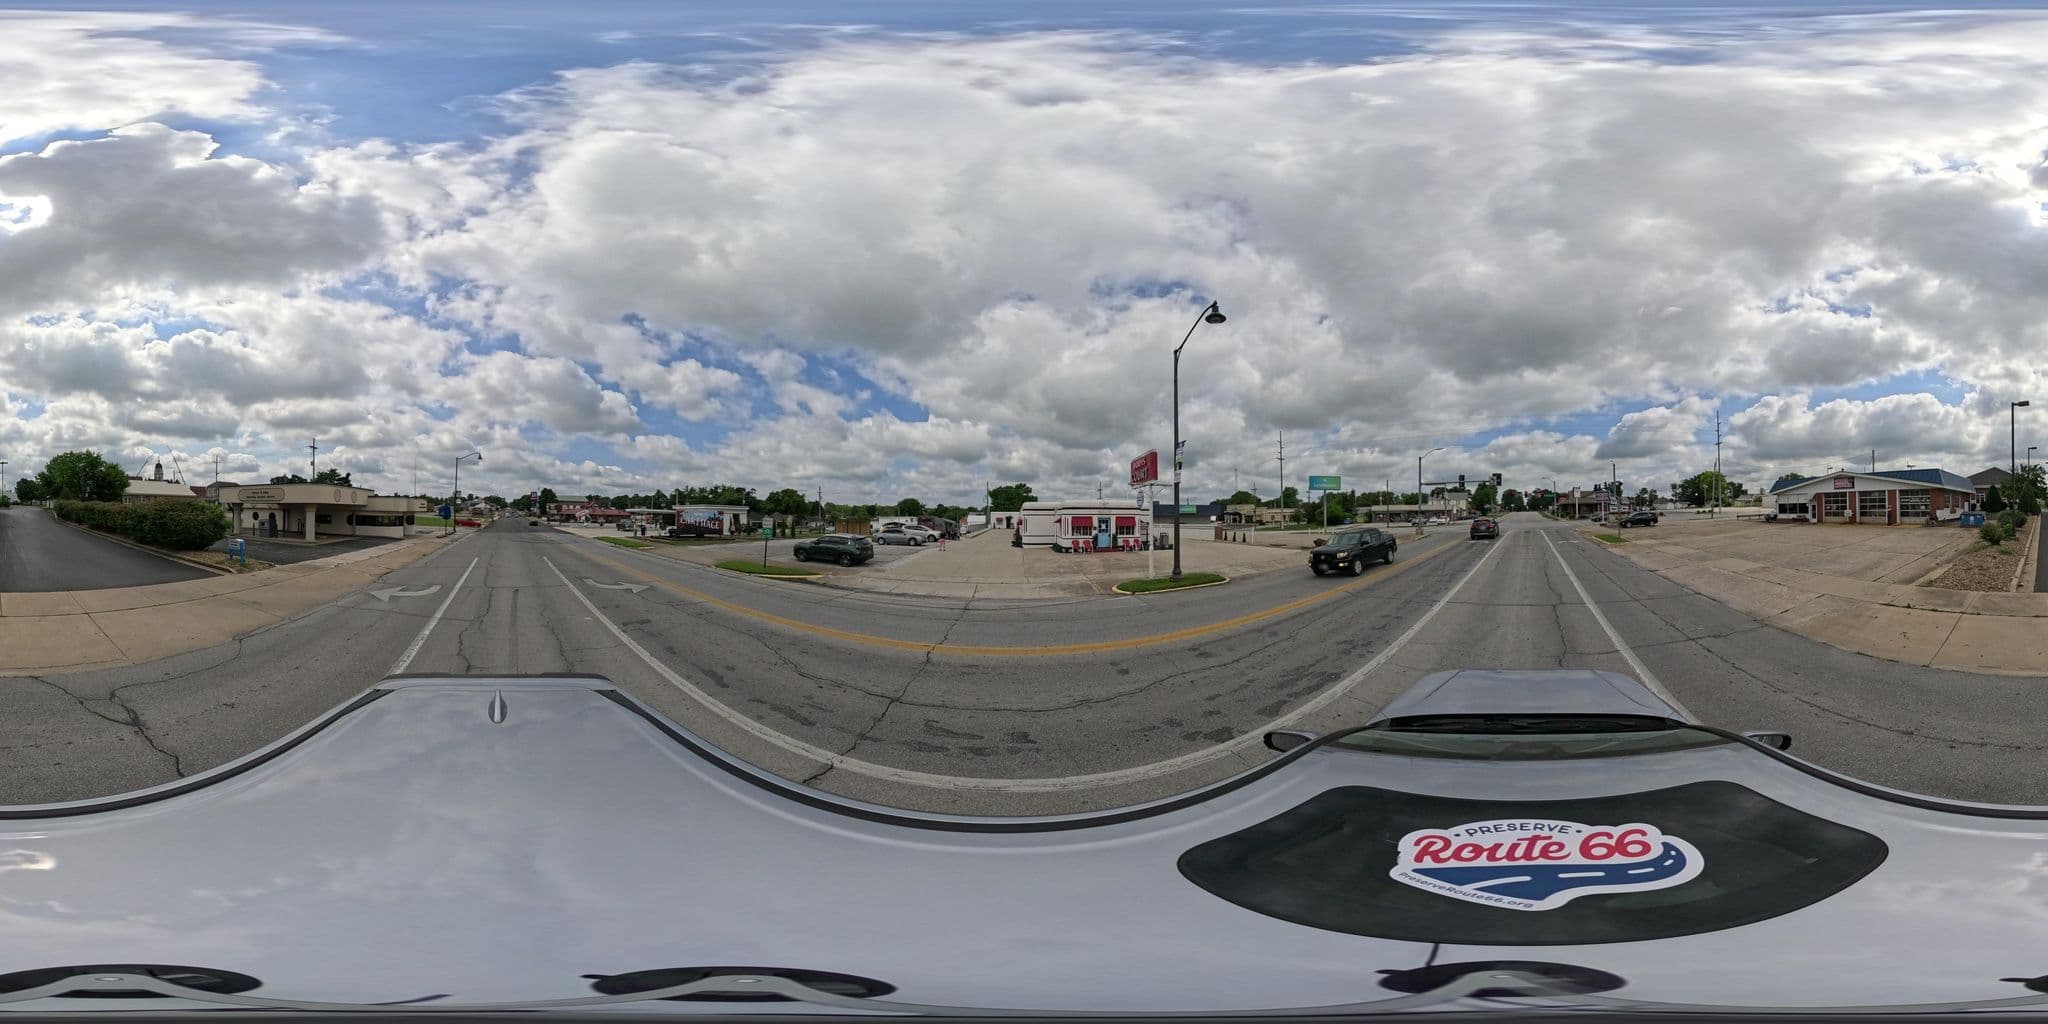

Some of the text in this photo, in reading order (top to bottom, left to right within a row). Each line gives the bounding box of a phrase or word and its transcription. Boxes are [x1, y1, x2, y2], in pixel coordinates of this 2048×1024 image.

[1413, 829, 1653, 864] Route 66
[1465, 822, 1572, 837] PRESERVE
[1398, 871, 1535, 909] PreserveRoute66.org
